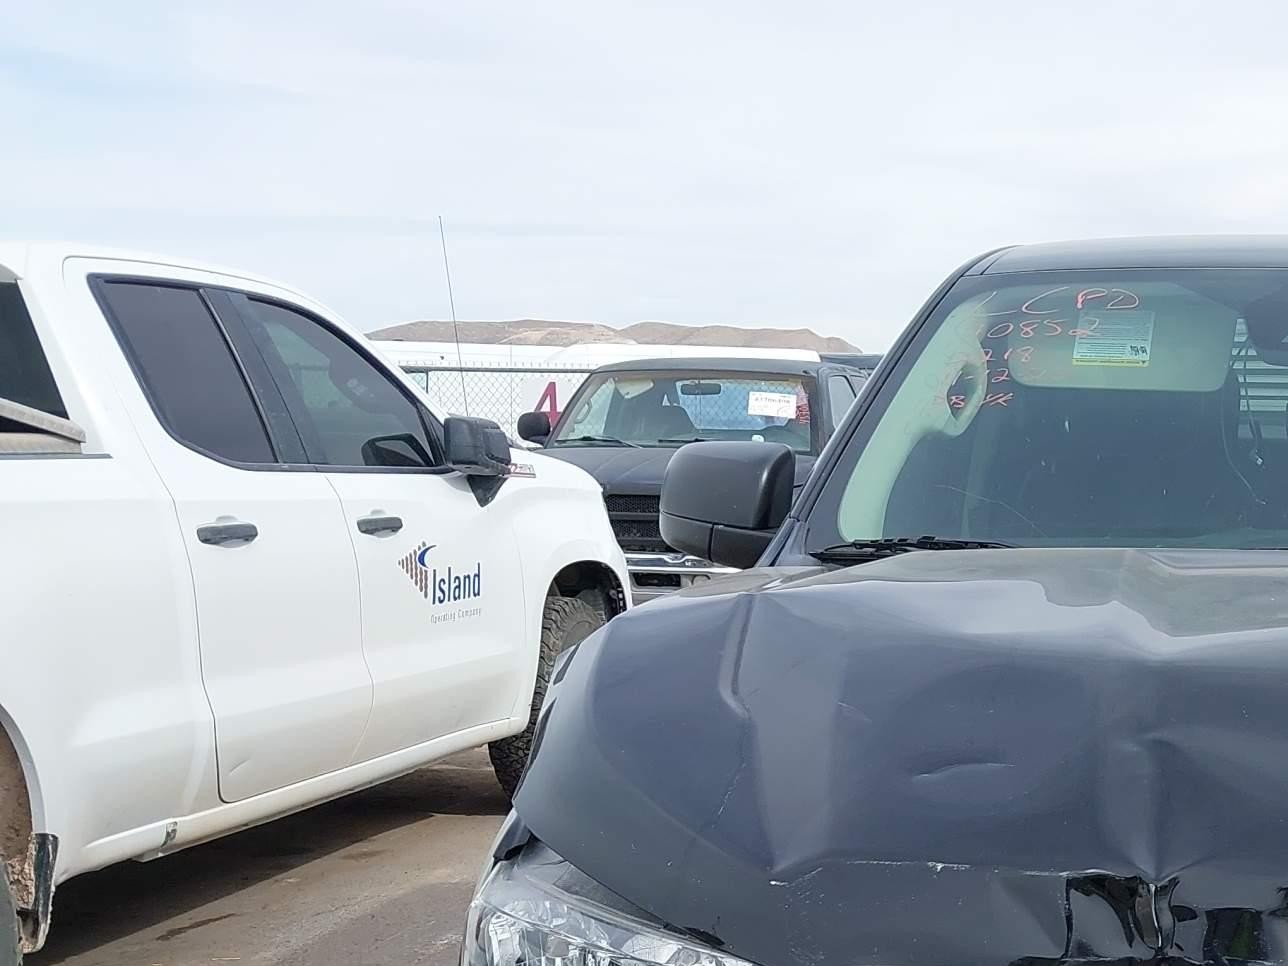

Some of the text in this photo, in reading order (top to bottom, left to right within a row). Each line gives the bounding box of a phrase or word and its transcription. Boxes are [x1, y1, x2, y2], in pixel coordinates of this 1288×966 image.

[431, 561, 482, 606] Island
[430, 607, 482, 624] Operating Company
